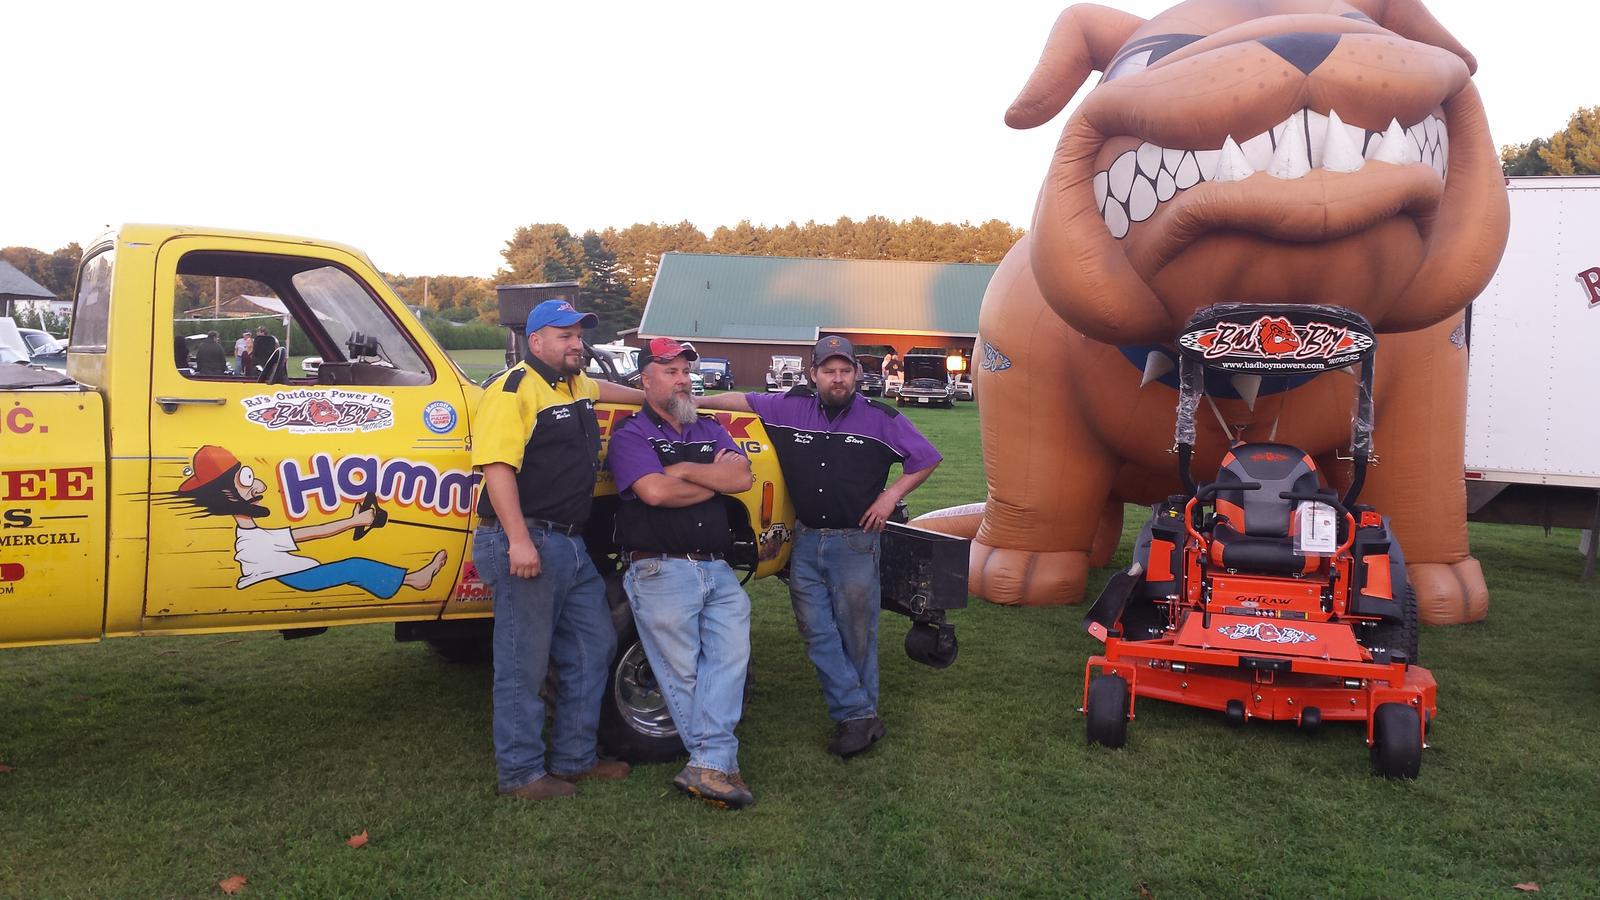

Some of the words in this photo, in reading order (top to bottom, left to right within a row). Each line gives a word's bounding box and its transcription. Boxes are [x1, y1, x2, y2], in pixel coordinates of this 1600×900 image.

[1204, 323, 1257, 358] Bad
[1295, 322, 1348, 358] Boy
[1222, 361, 1325, 371] www.badboymowers.com
[244, 397, 271, 408] RJ's
[276, 390, 326, 401] Outdoor
[331, 390, 368, 401] Power
[371, 394, 392, 406] Inc.
[268, 403, 307, 428] Bad
[337, 402, 372, 427] Boy
[0, 508, 33, 529] S
